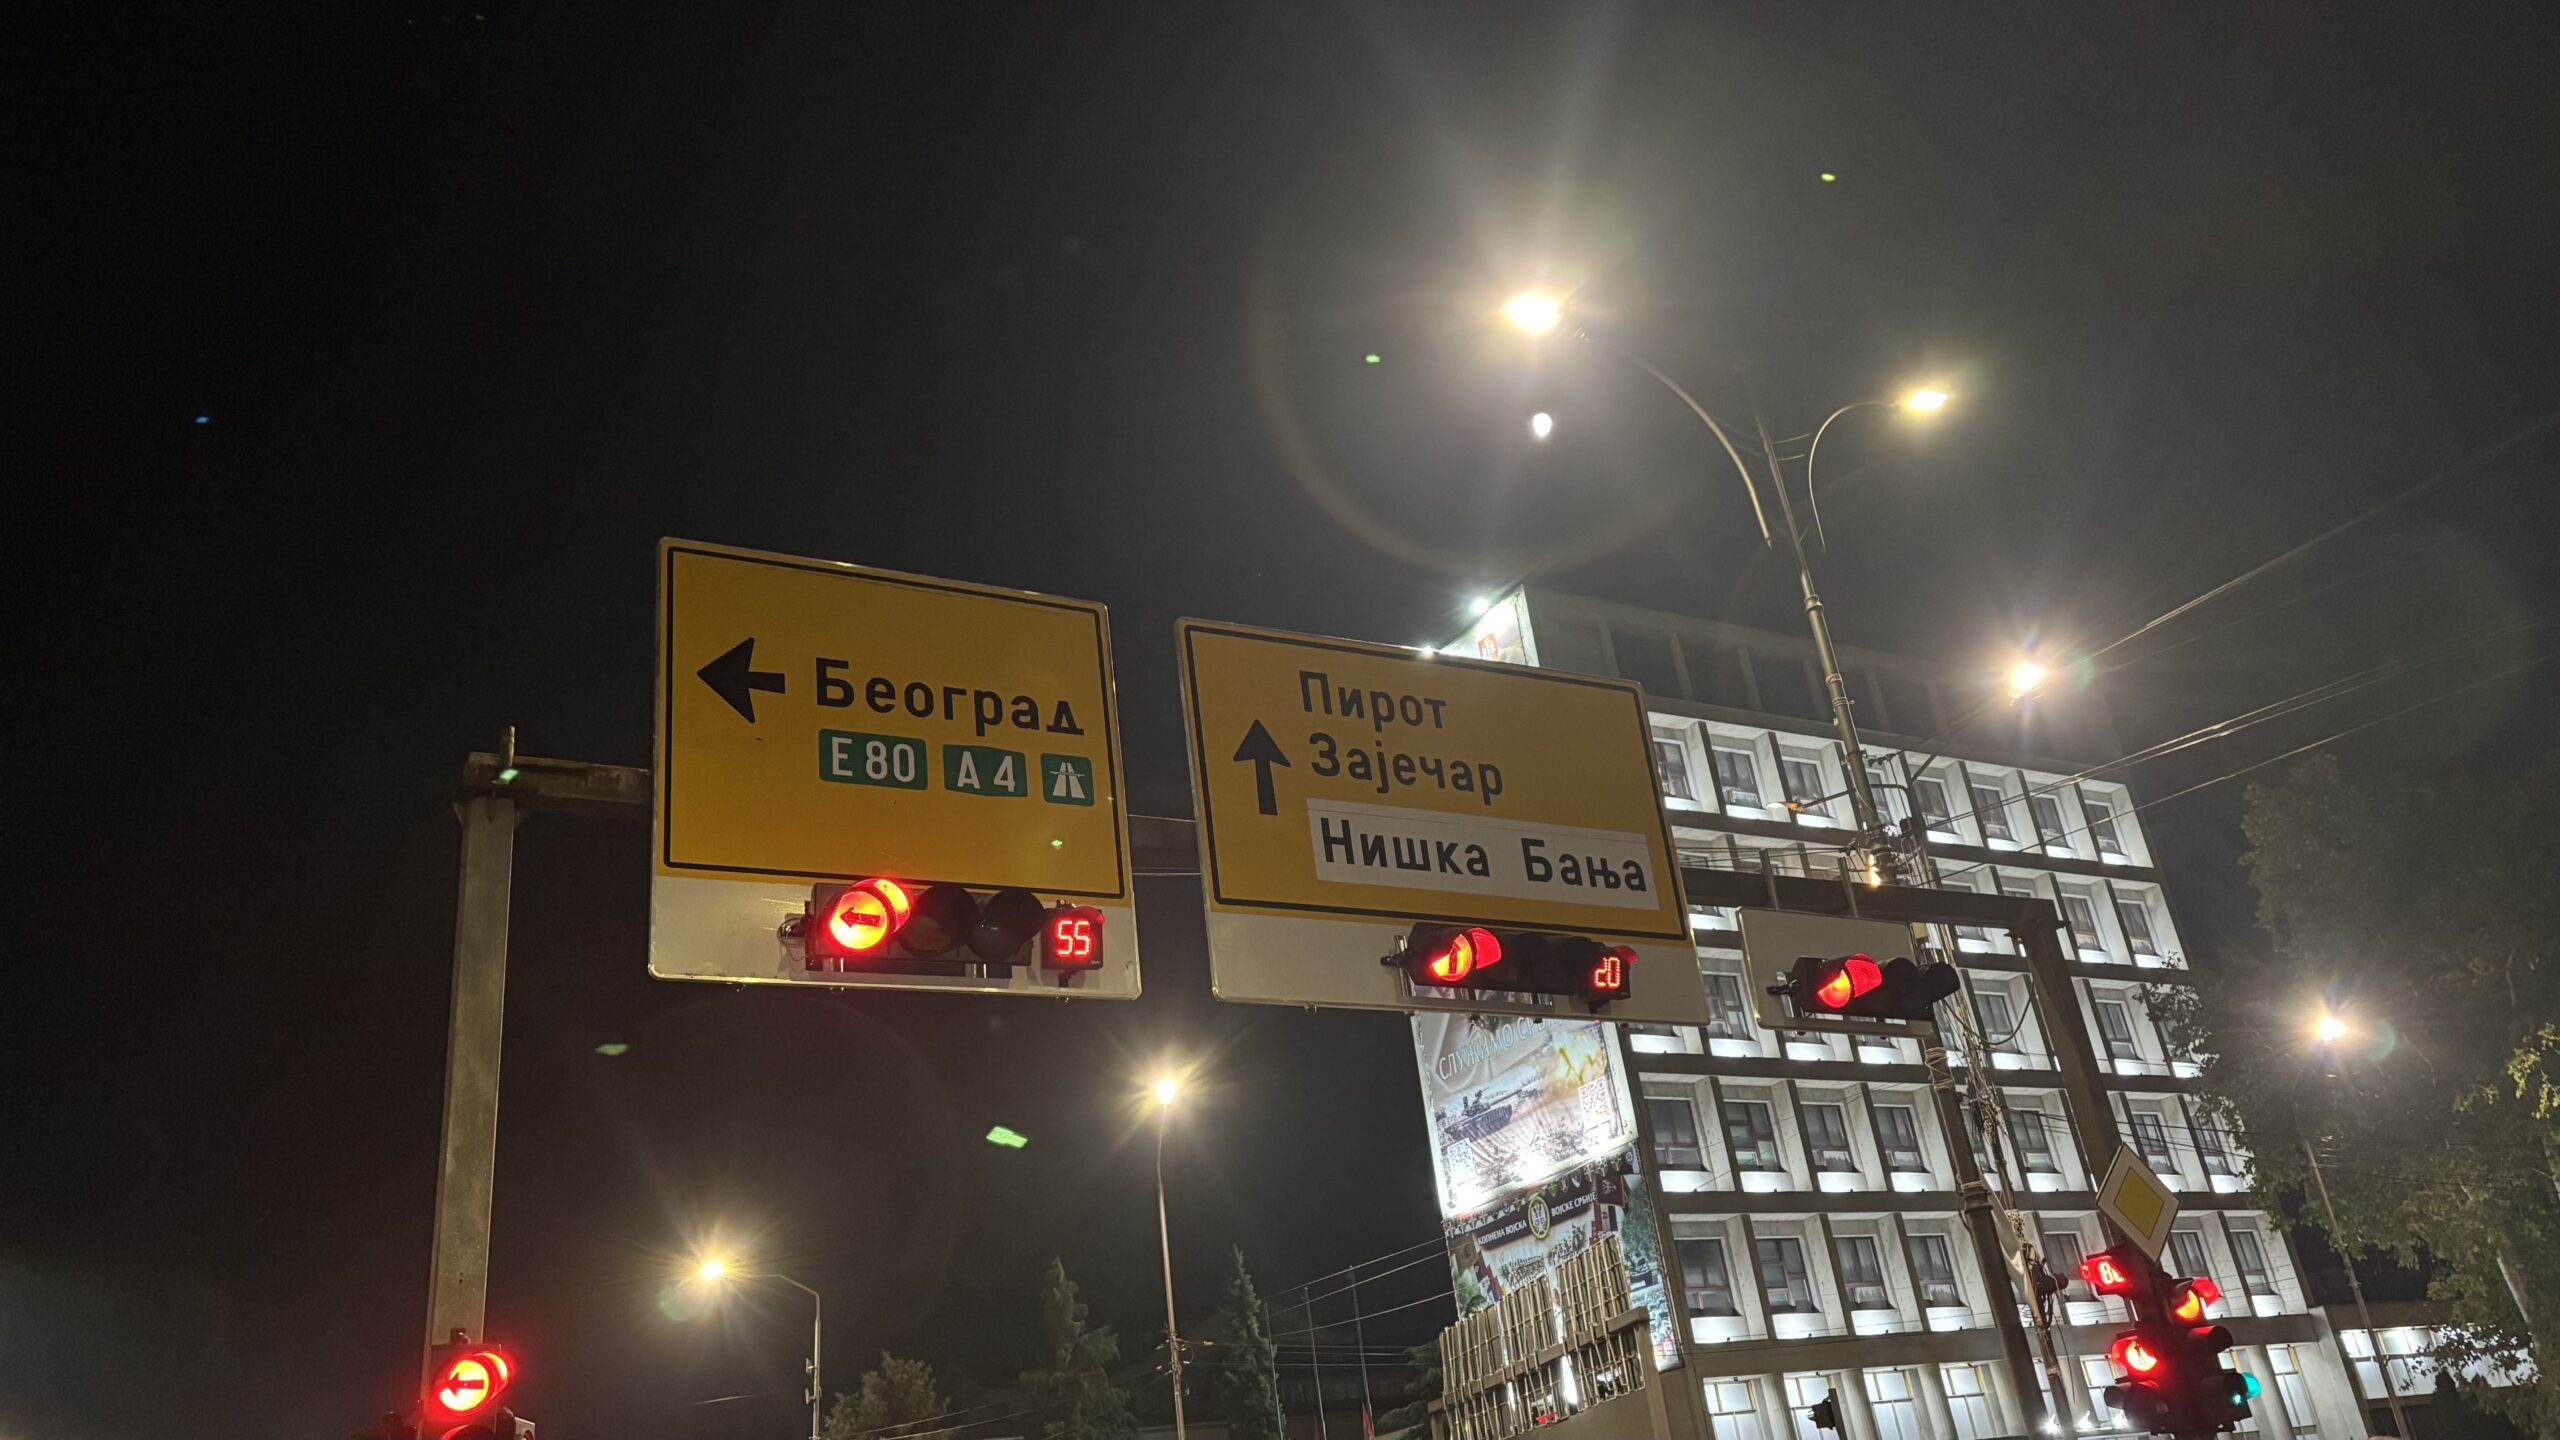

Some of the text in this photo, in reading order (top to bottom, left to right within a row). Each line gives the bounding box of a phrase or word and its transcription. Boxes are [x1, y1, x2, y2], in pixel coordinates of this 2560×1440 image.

[815, 656, 1085, 737] Београд
[1299, 669, 1447, 733] Пирот
[831, 736, 916, 783] E 80
[957, 750, 1016, 793] A 4
[1308, 731, 1504, 806] Зајечар
[1319, 816, 1647, 893] Нишка Бања
[1057, 919, 1091, 956] 55
[1594, 956, 1621, 989] 20
[1438, 1022, 1514, 1081] СЛУЖИМО
